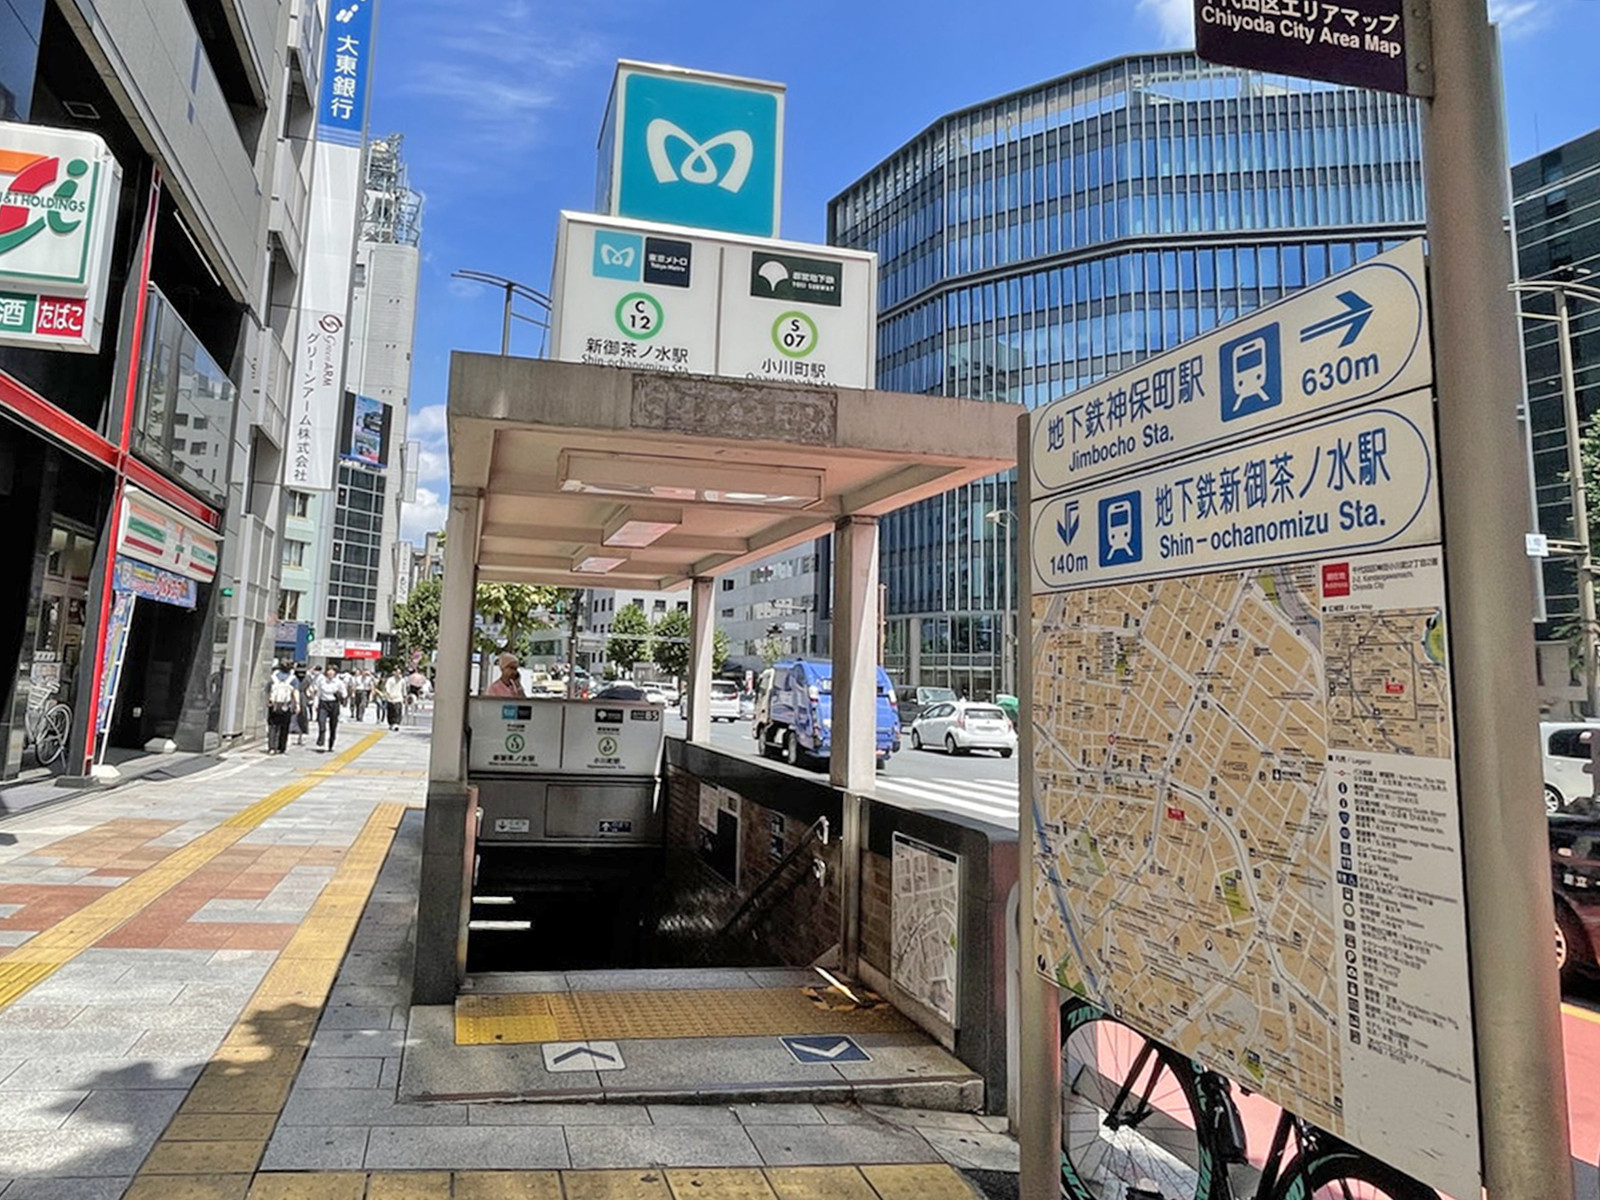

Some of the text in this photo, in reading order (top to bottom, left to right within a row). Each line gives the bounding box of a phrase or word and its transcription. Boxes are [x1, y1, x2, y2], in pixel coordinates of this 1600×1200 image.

[1202, 5, 1401, 58] Chiyoda City Area Map
[330, 35, 360, 120] 大東銀行
[21, 193, 86, 213] HOLDINGS
[38, 302, 83, 331] たばこ
[635, 300, 645, 313] C
[630, 314, 650, 330] 12
[791, 319, 800, 332] S
[585, 337, 688, 363] 新御茶ノ水駅
[783, 333, 806, 347] 07
[761, 358, 826, 379] 小川町駅
[1301, 352, 1380, 396] 630m
[294, 332, 321, 482] グリーンアーム株式会社
[1047, 355, 1206, 452] 地下鉄神保町駅
[1068, 422, 1174, 473] Jimbocho Sta.
[1154, 427, 1391, 529] 地下鉄新御茶ノ水駅
[1159, 500, 1387, 560] Shin-ochanomizu Sta.
[1049, 555, 1089, 576] 140m
